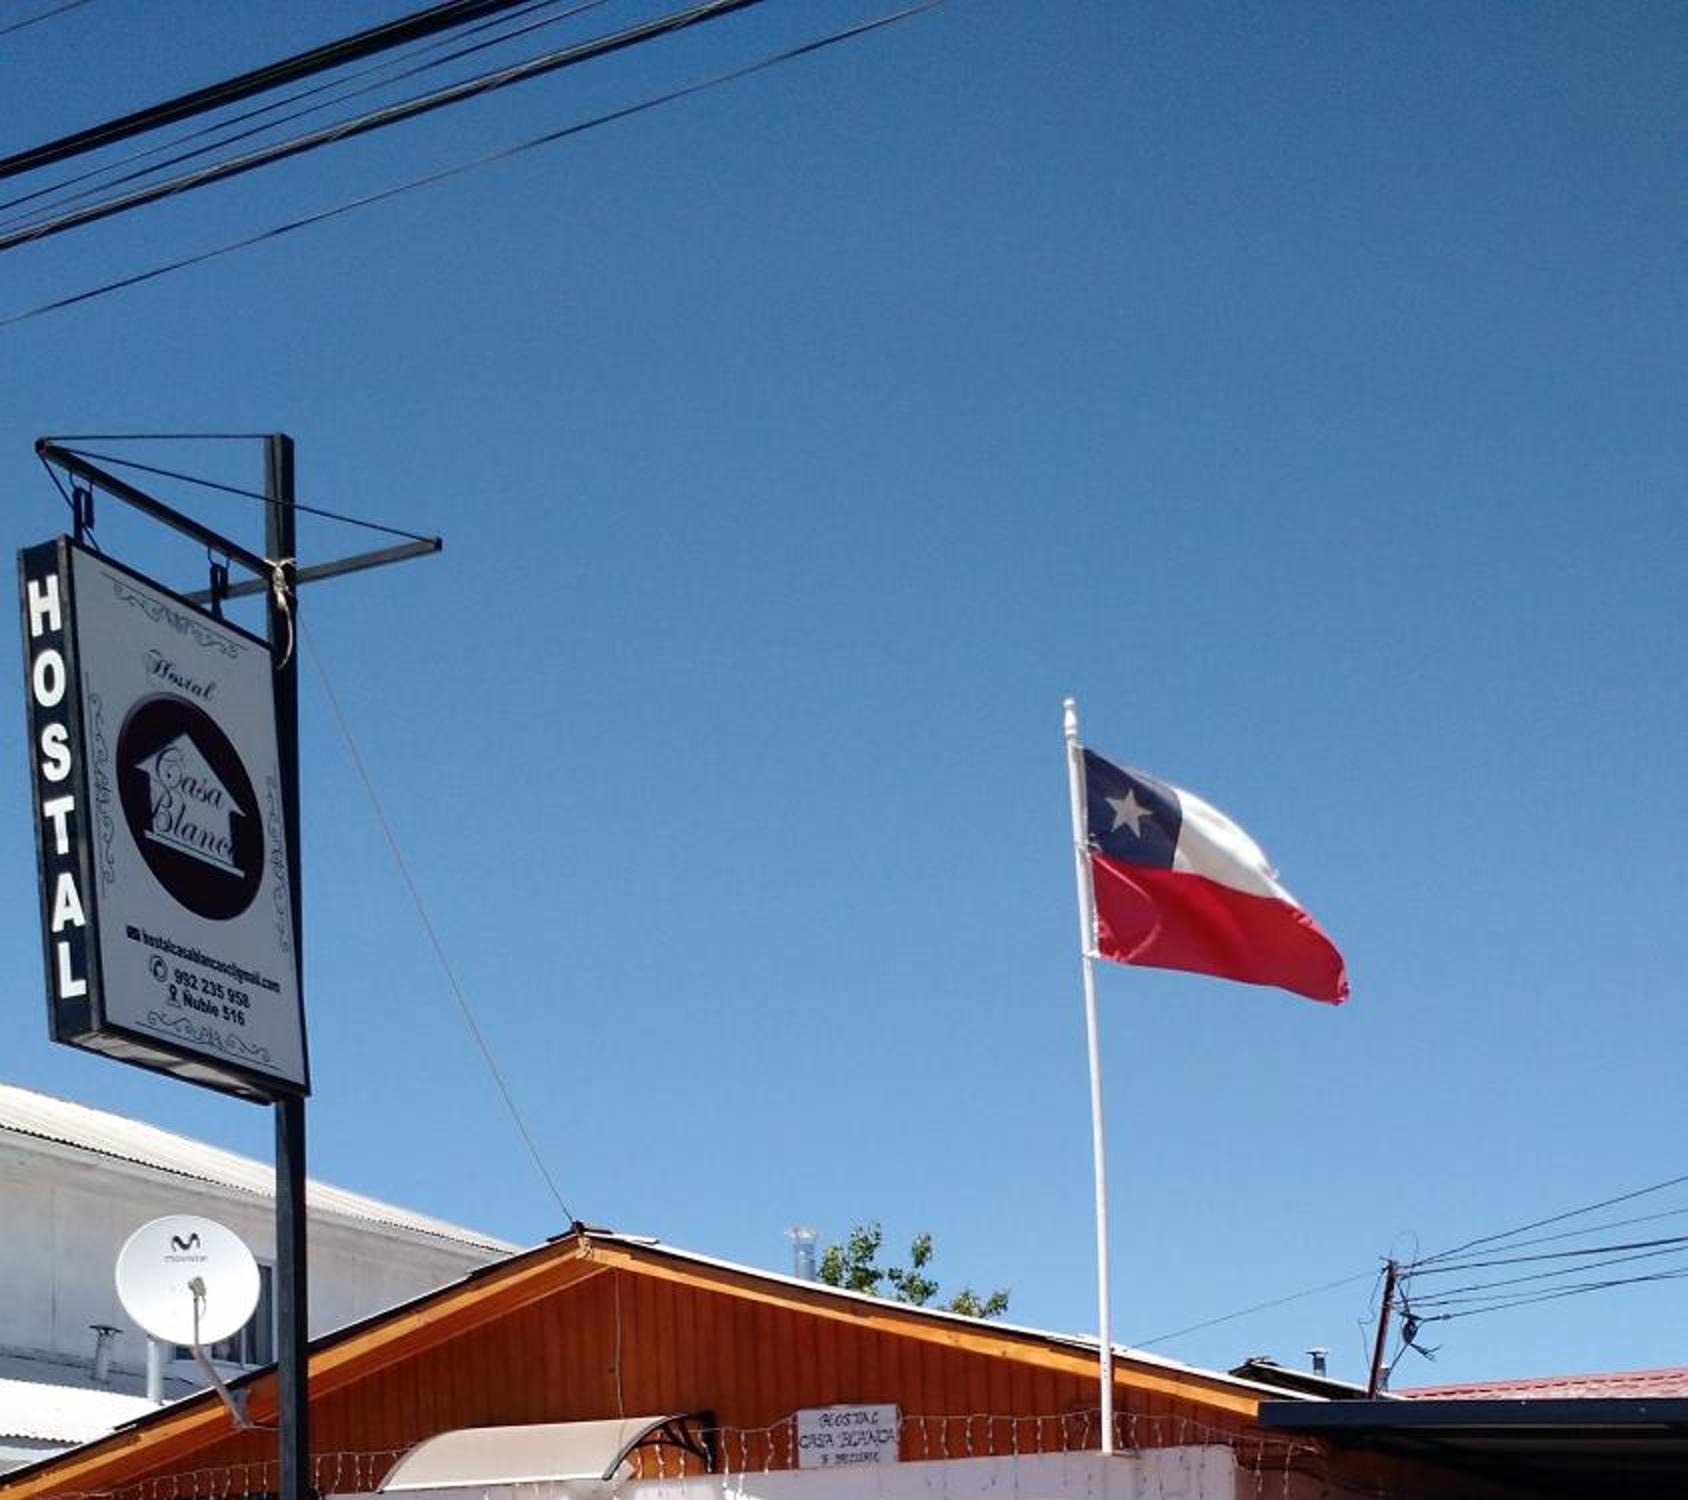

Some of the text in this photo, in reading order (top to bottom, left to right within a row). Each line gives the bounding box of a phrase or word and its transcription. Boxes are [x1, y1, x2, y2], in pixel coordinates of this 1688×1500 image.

[146, 650, 216, 701] Hostal
[28, 574, 87, 999] HOSTAL
[154, 747, 223, 808] Casa
[153, 790, 233, 856] Blanc
[174, 968, 198, 990] 992
[201, 978, 225, 1000] 235
[223, 1005, 246, 1027] 516
